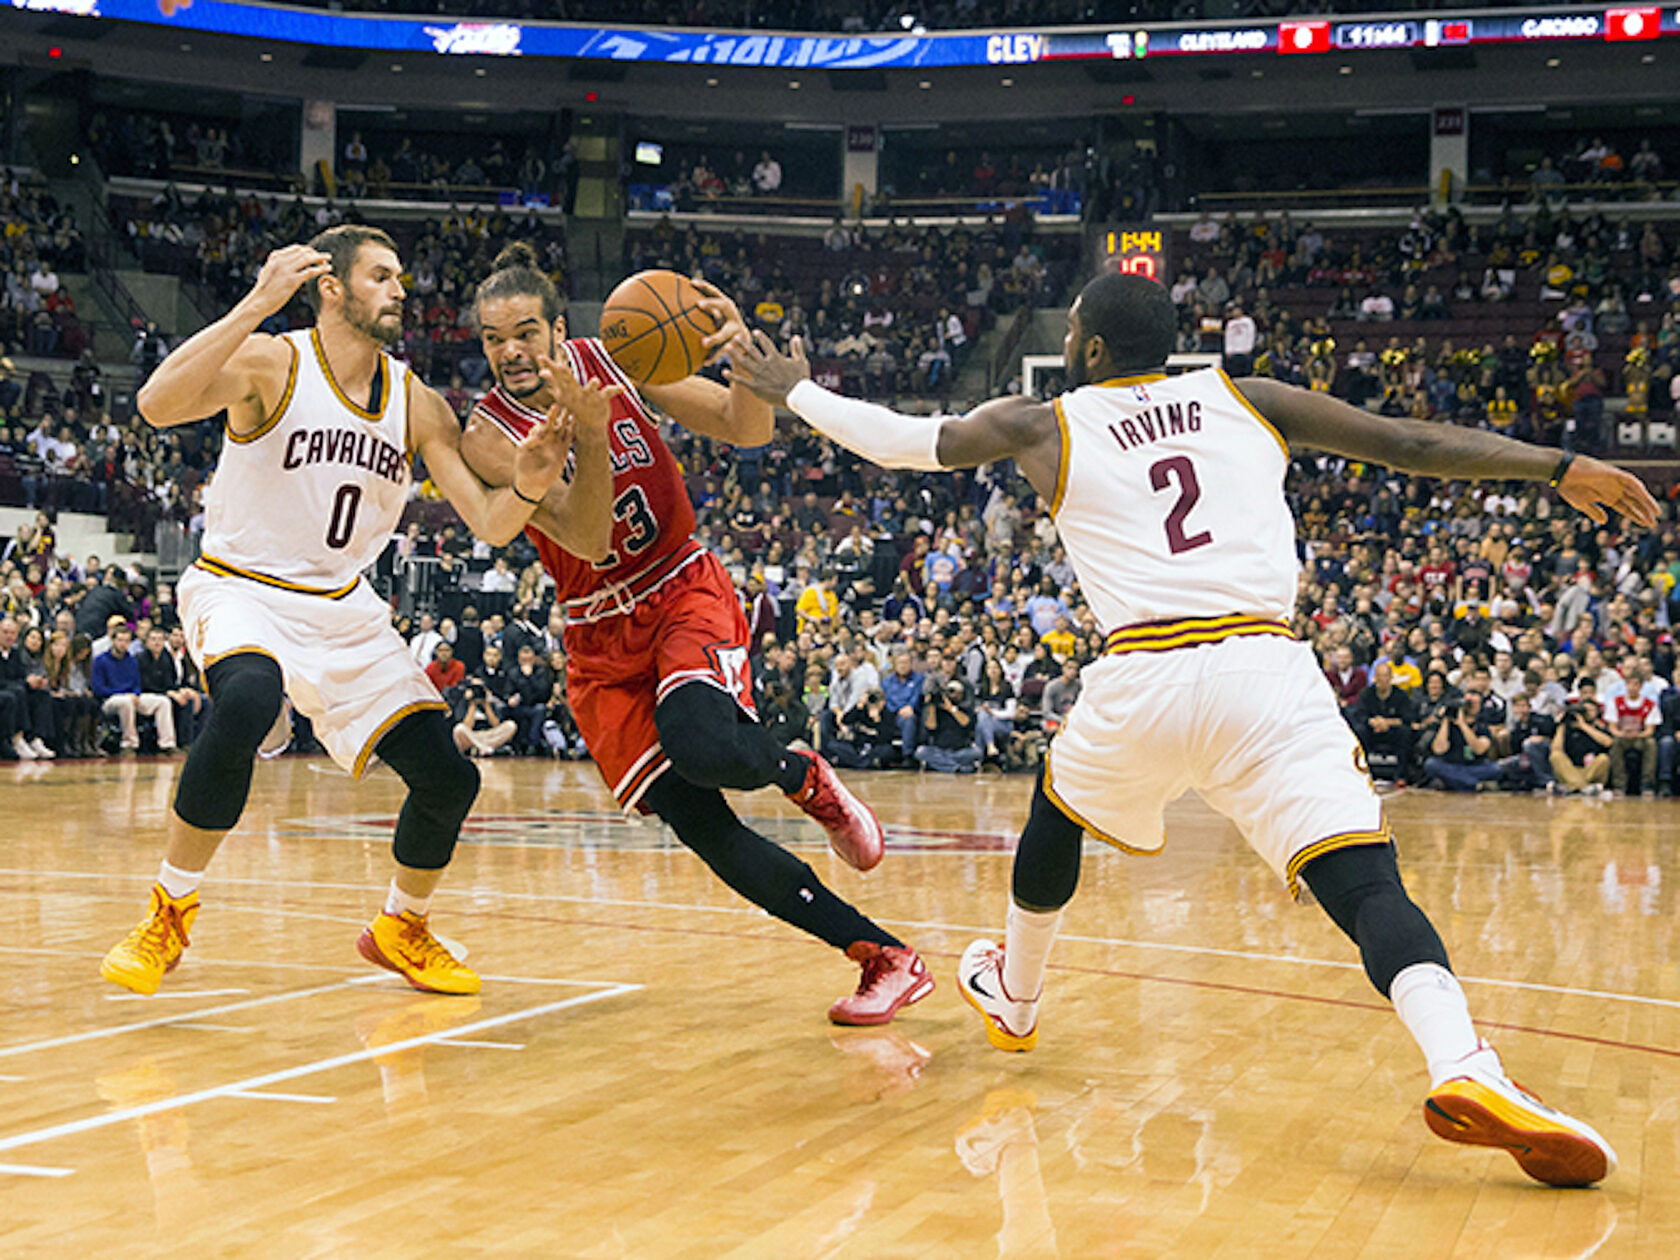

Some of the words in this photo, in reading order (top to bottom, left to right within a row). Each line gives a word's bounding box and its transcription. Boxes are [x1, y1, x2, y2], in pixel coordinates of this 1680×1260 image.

[1107, 231, 1162, 254] 11:44
[1108, 400, 1201, 452] IRVING
[326, 483, 362, 549] 0
[1149, 455, 1214, 556] 2
